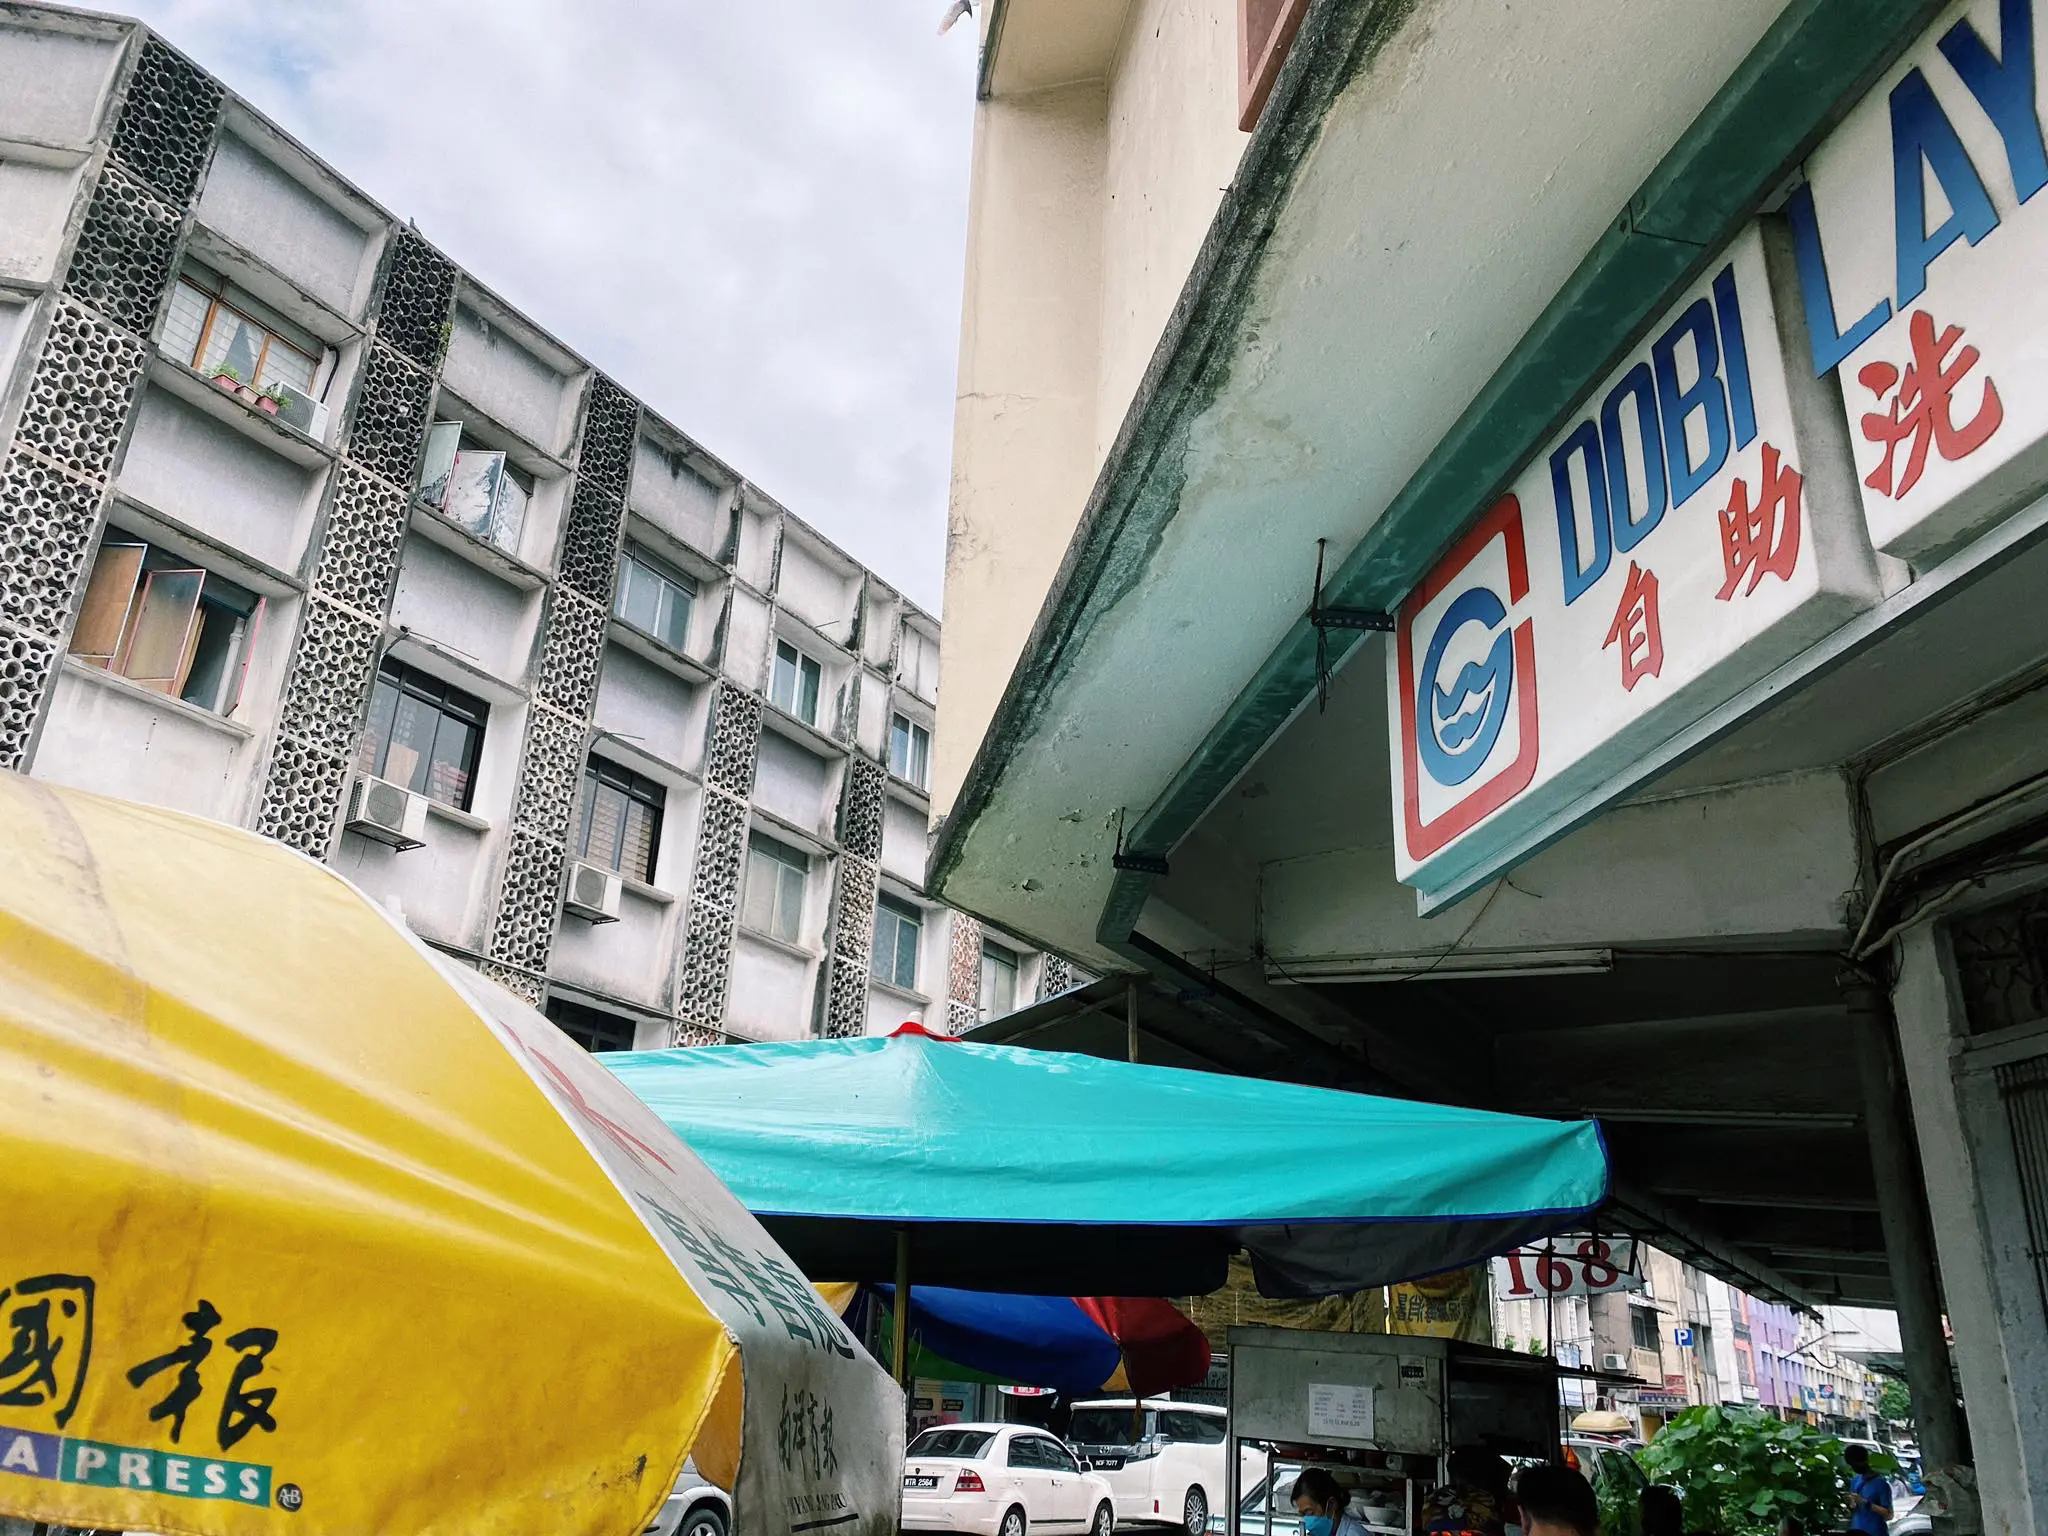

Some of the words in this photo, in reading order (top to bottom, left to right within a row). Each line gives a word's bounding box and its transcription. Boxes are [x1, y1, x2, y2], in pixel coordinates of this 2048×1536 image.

[1548, 262, 1757, 606] DOBI
[1787, 0, 2048, 380] LAY
[1508, 1240, 1618, 1296] 168
[1677, 1329, 1689, 1346] P
[75, 1446, 260, 1501] PRESS
